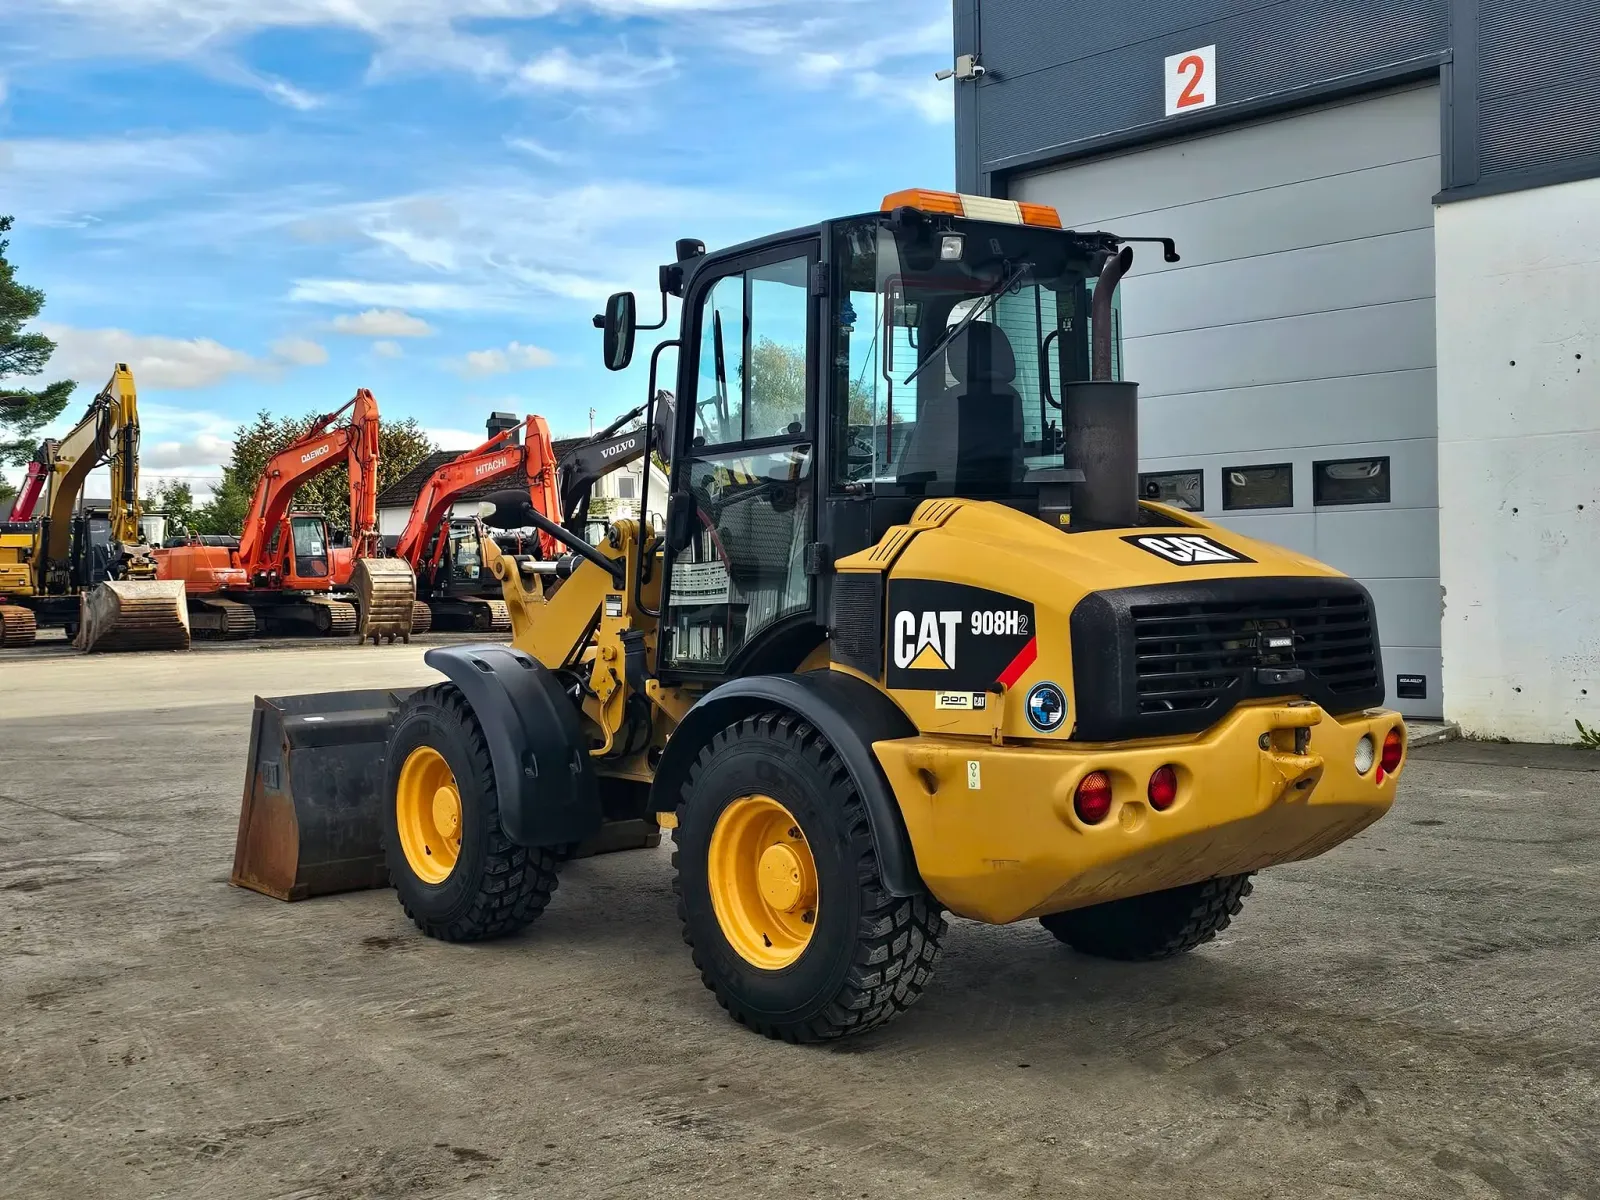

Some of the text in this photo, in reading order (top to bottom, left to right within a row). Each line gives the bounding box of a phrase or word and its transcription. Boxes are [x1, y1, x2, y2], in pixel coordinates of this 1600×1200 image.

[1176, 55, 1204, 108] 2
[301, 445, 329, 463] DAEWOO
[600, 439, 636, 458] VOLVO
[475, 457, 507, 475] HITACHI
[1138, 536, 1241, 562] CAT
[894, 610, 962, 670] CAT
[941, 696, 985, 706] pon CAT
